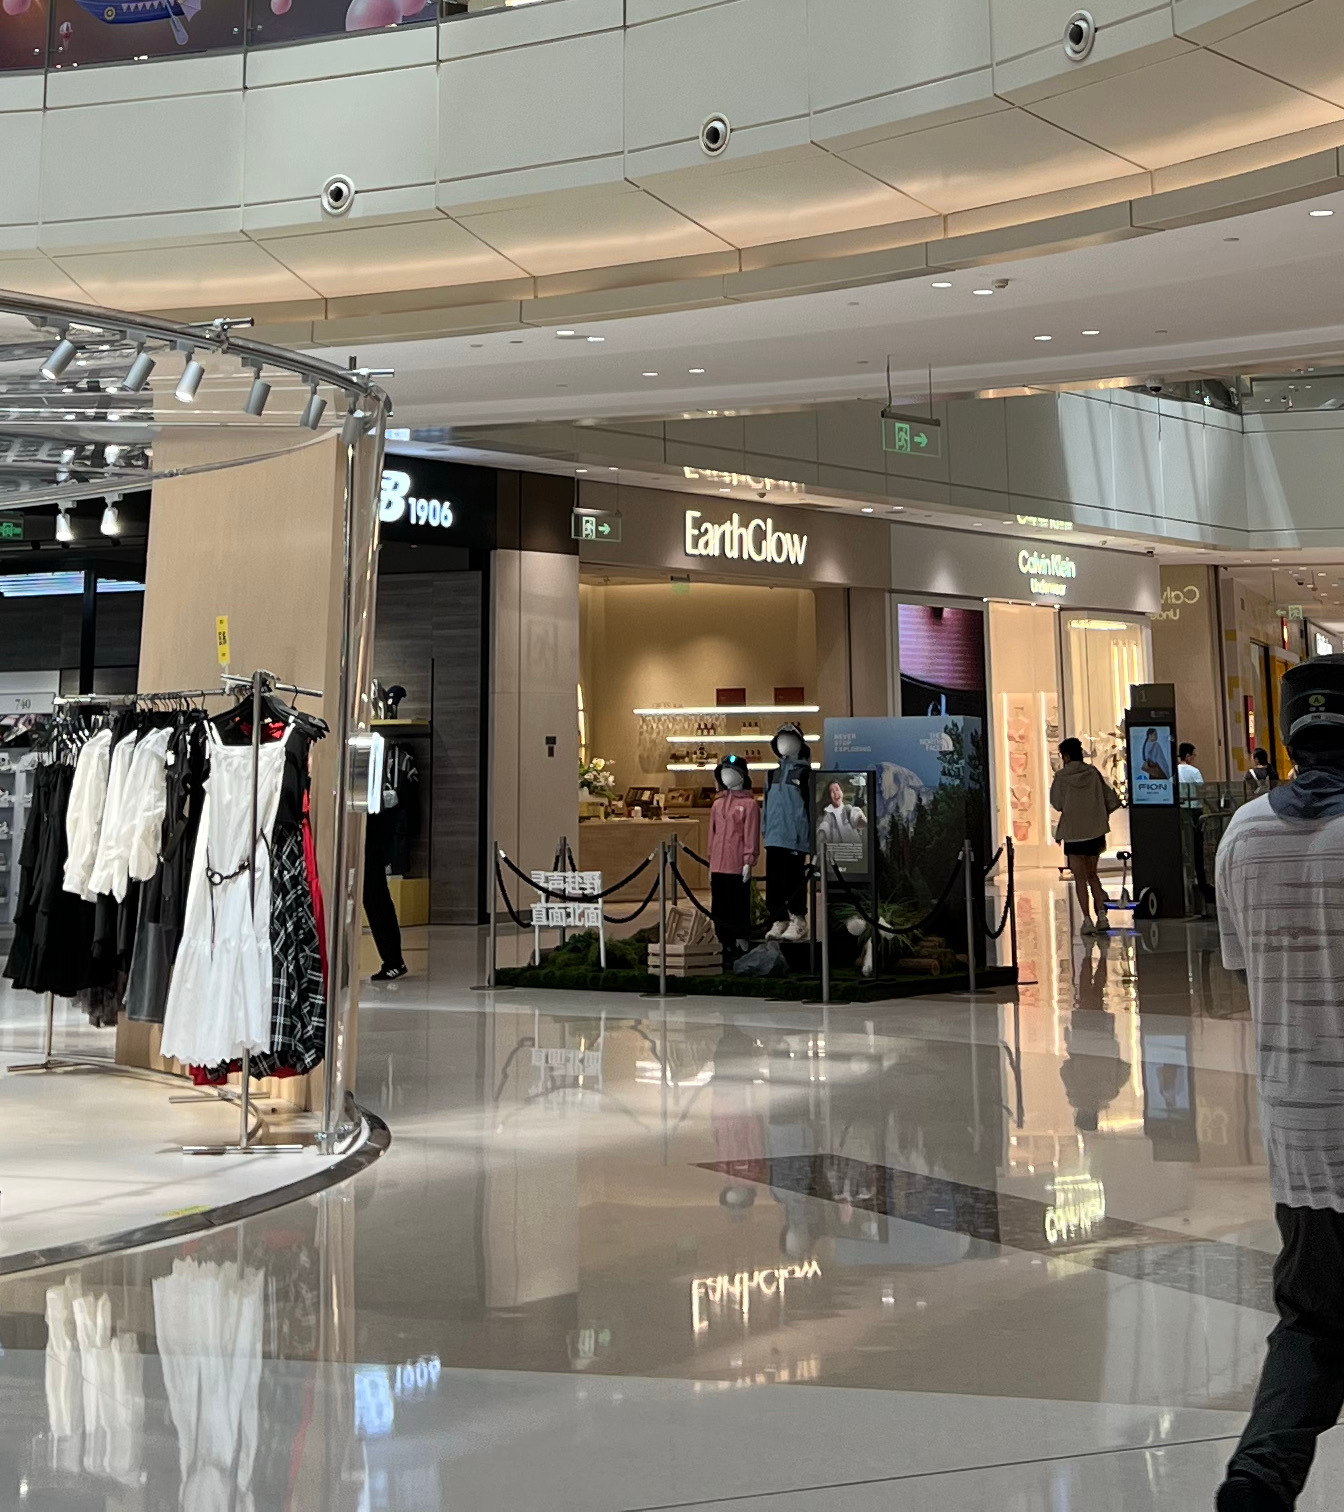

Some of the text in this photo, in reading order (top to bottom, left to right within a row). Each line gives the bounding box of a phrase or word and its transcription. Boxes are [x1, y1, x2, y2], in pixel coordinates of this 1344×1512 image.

[409, 497, 453, 528] 1906
[684, 510, 808, 565] EarthGlow
[1138, 783, 1167, 791] FION
[530, 902, 602, 927] 直面北面
